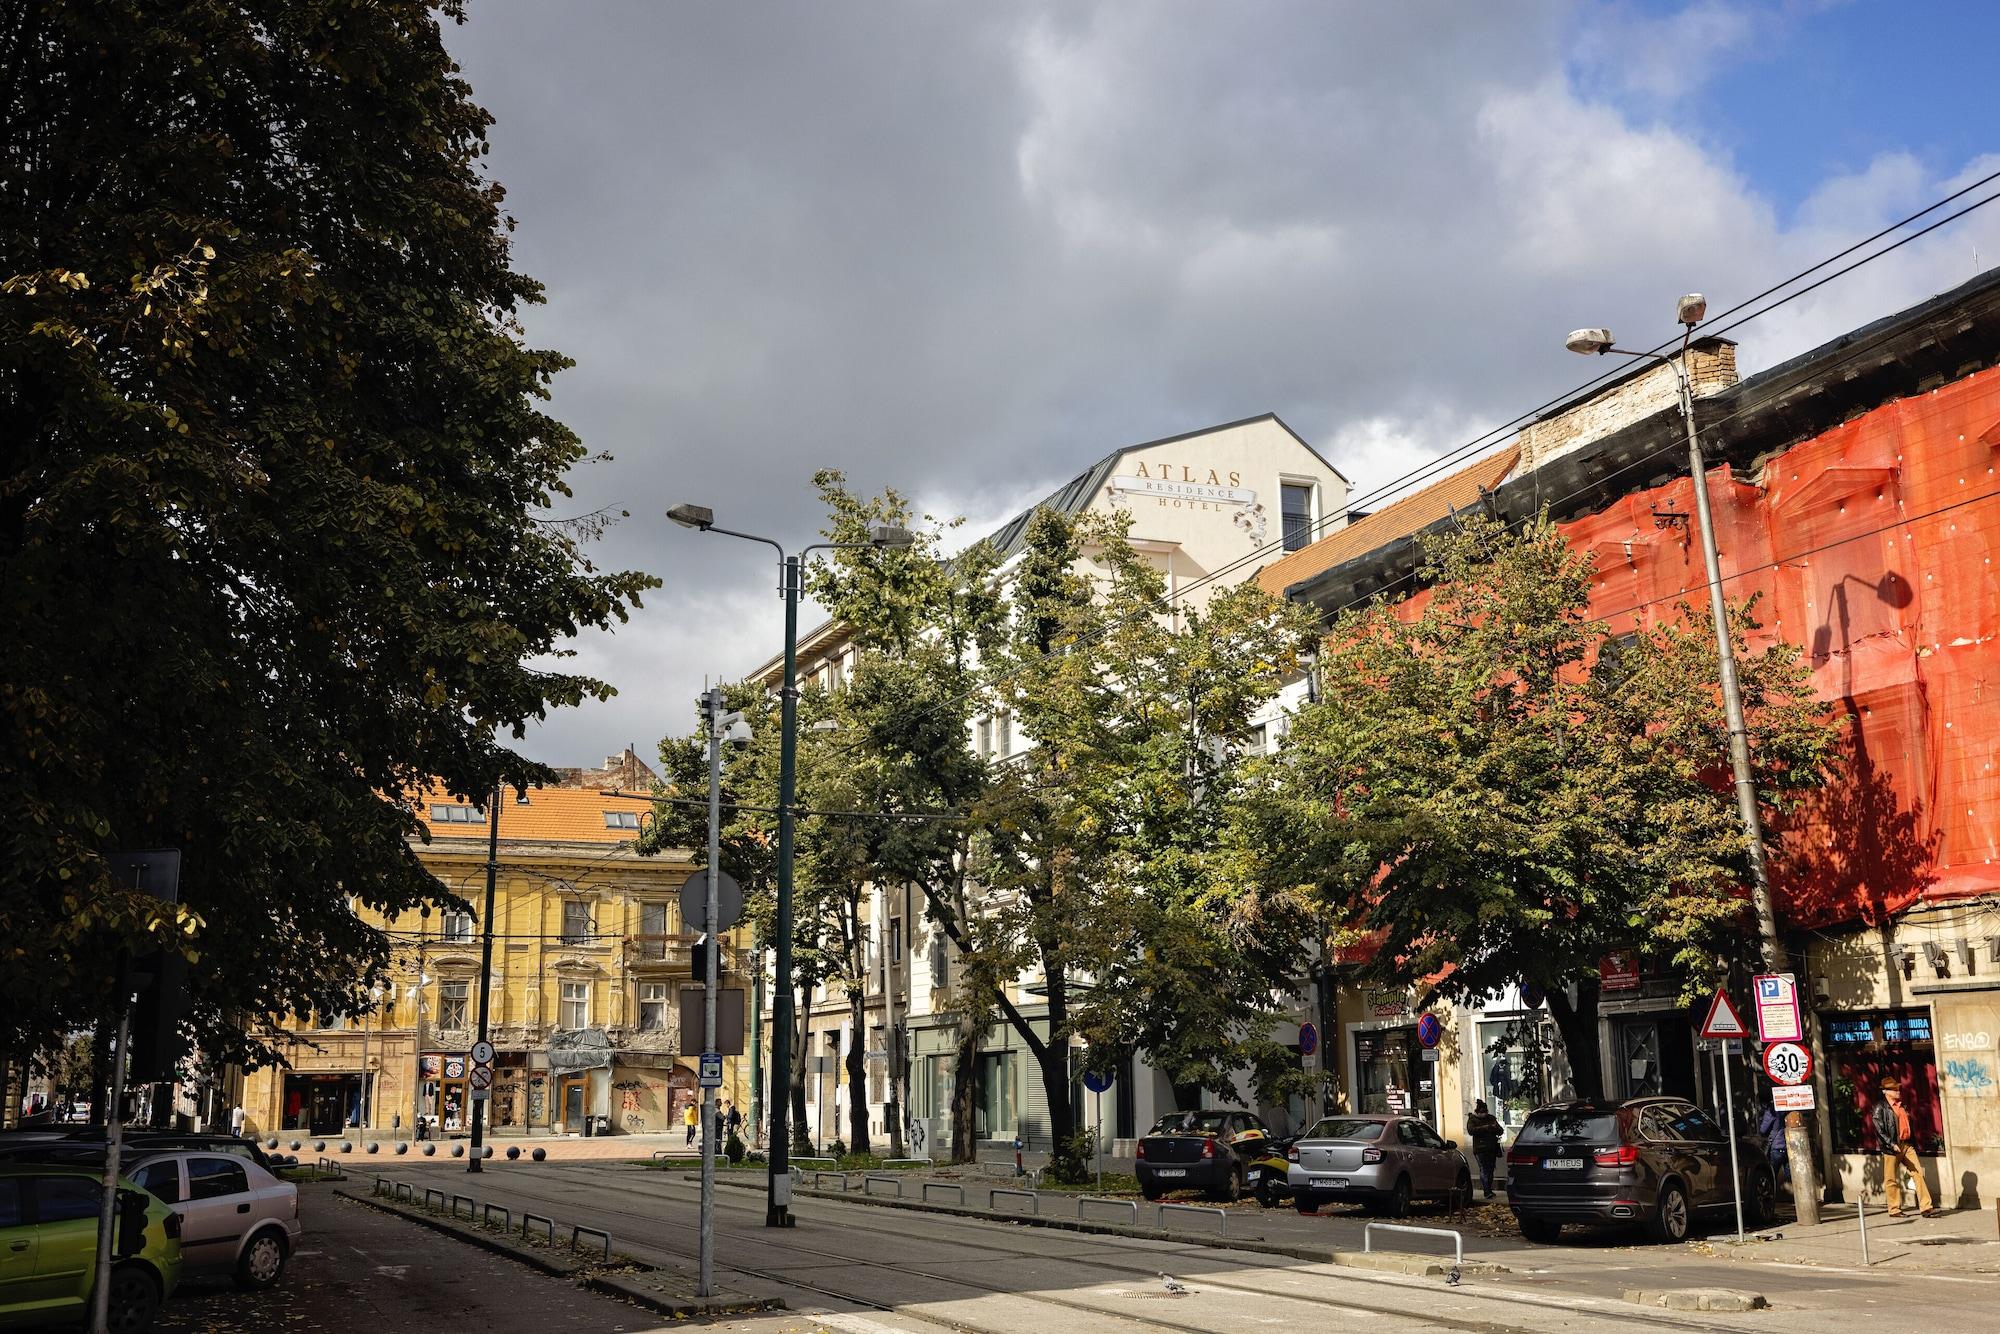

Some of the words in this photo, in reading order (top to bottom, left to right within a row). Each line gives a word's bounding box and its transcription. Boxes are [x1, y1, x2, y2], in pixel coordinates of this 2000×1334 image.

[1136, 461, 1240, 487] ATLAS
[1146, 482, 1234, 498] RESIDENCE
[1159, 498, 1222, 512] HOTEL
[1765, 982, 1776, 996] P
[480, 1046, 486, 1059] 5
[1776, 1053, 1799, 1073] 30
